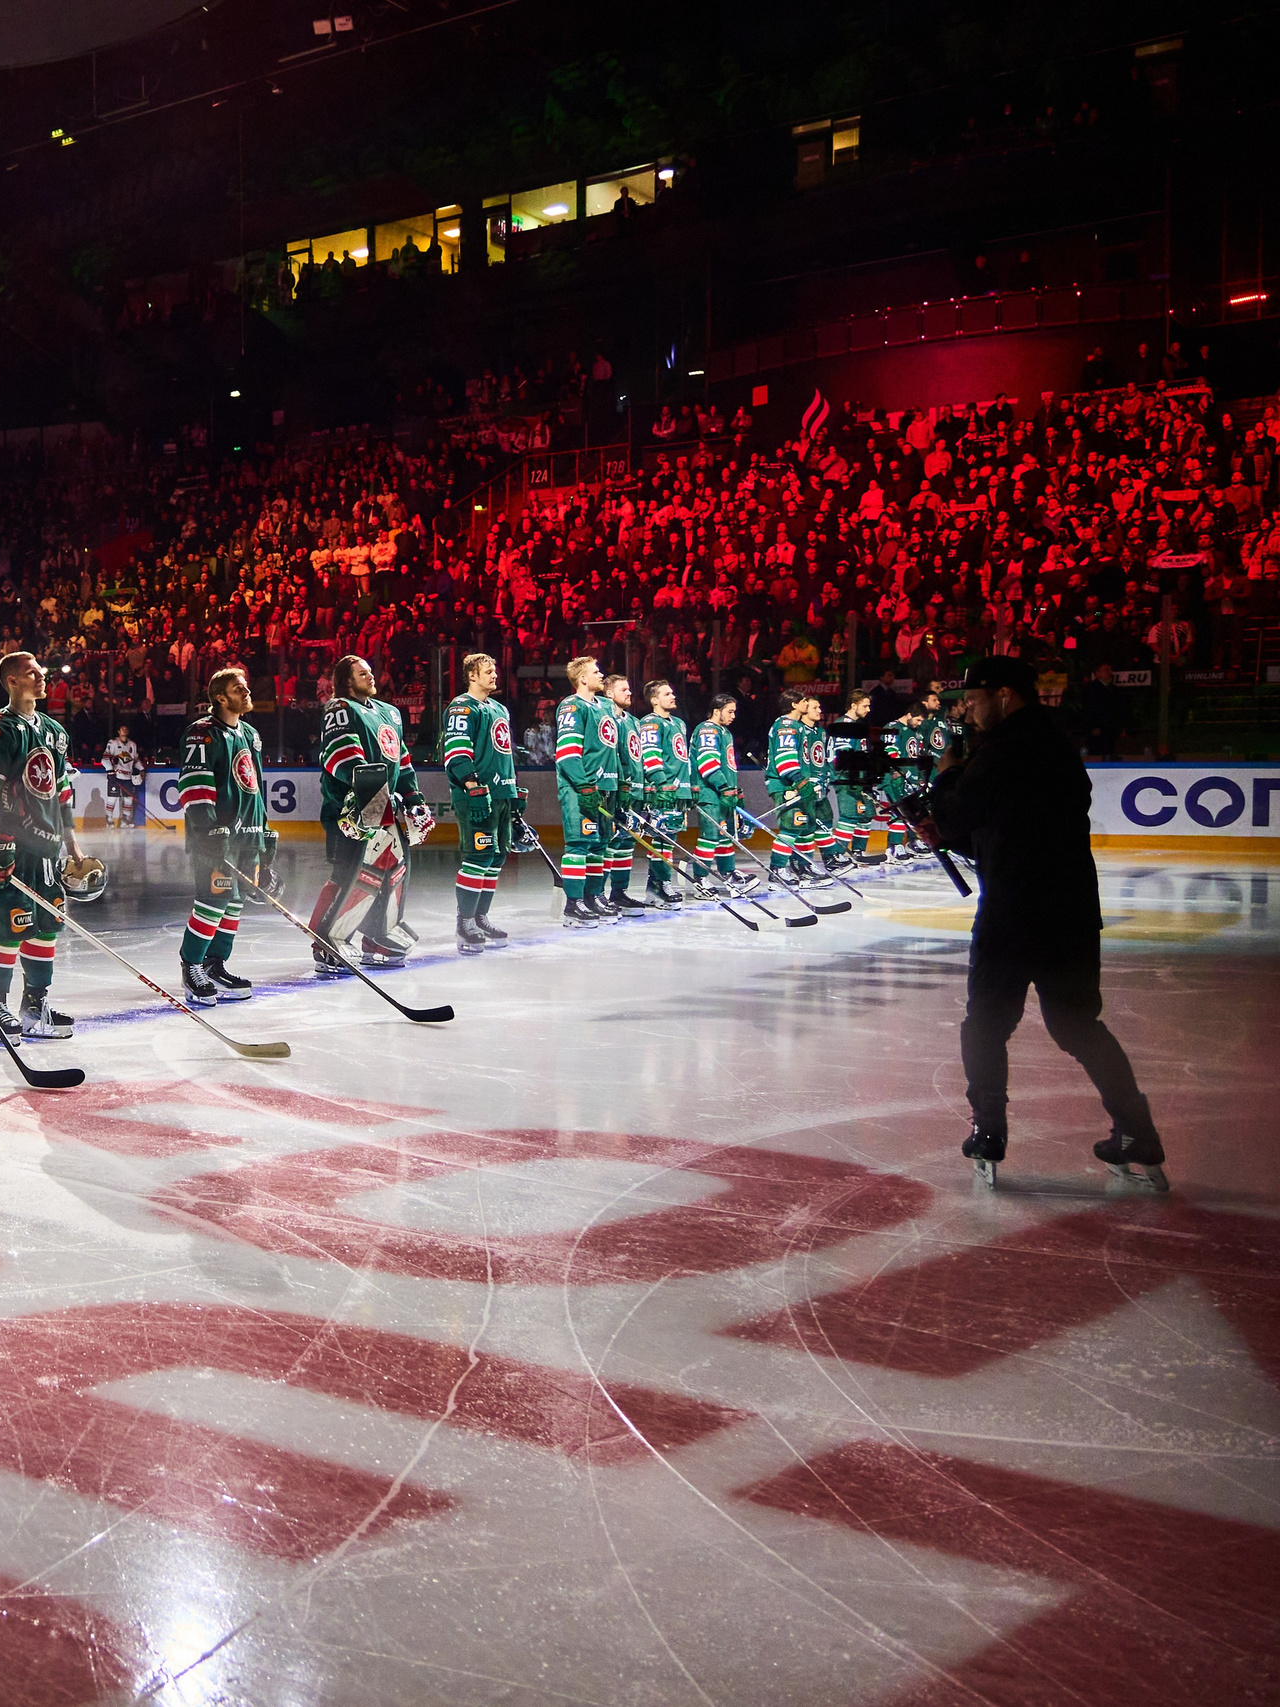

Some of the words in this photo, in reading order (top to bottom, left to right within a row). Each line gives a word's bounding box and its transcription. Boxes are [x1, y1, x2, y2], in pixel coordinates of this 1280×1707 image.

[530, 469, 548, 484] 12A
[1113, 673, 1148, 684] L.RU
[1184, 671, 1224, 681] WINLINE
[324, 708, 350, 730] 20
[447, 715, 468, 731] 96
[699, 734, 716, 746] 13
[778, 735, 795, 748] 14
[185, 743, 206, 764] 71
[17, 916, 32, 925] WIN
